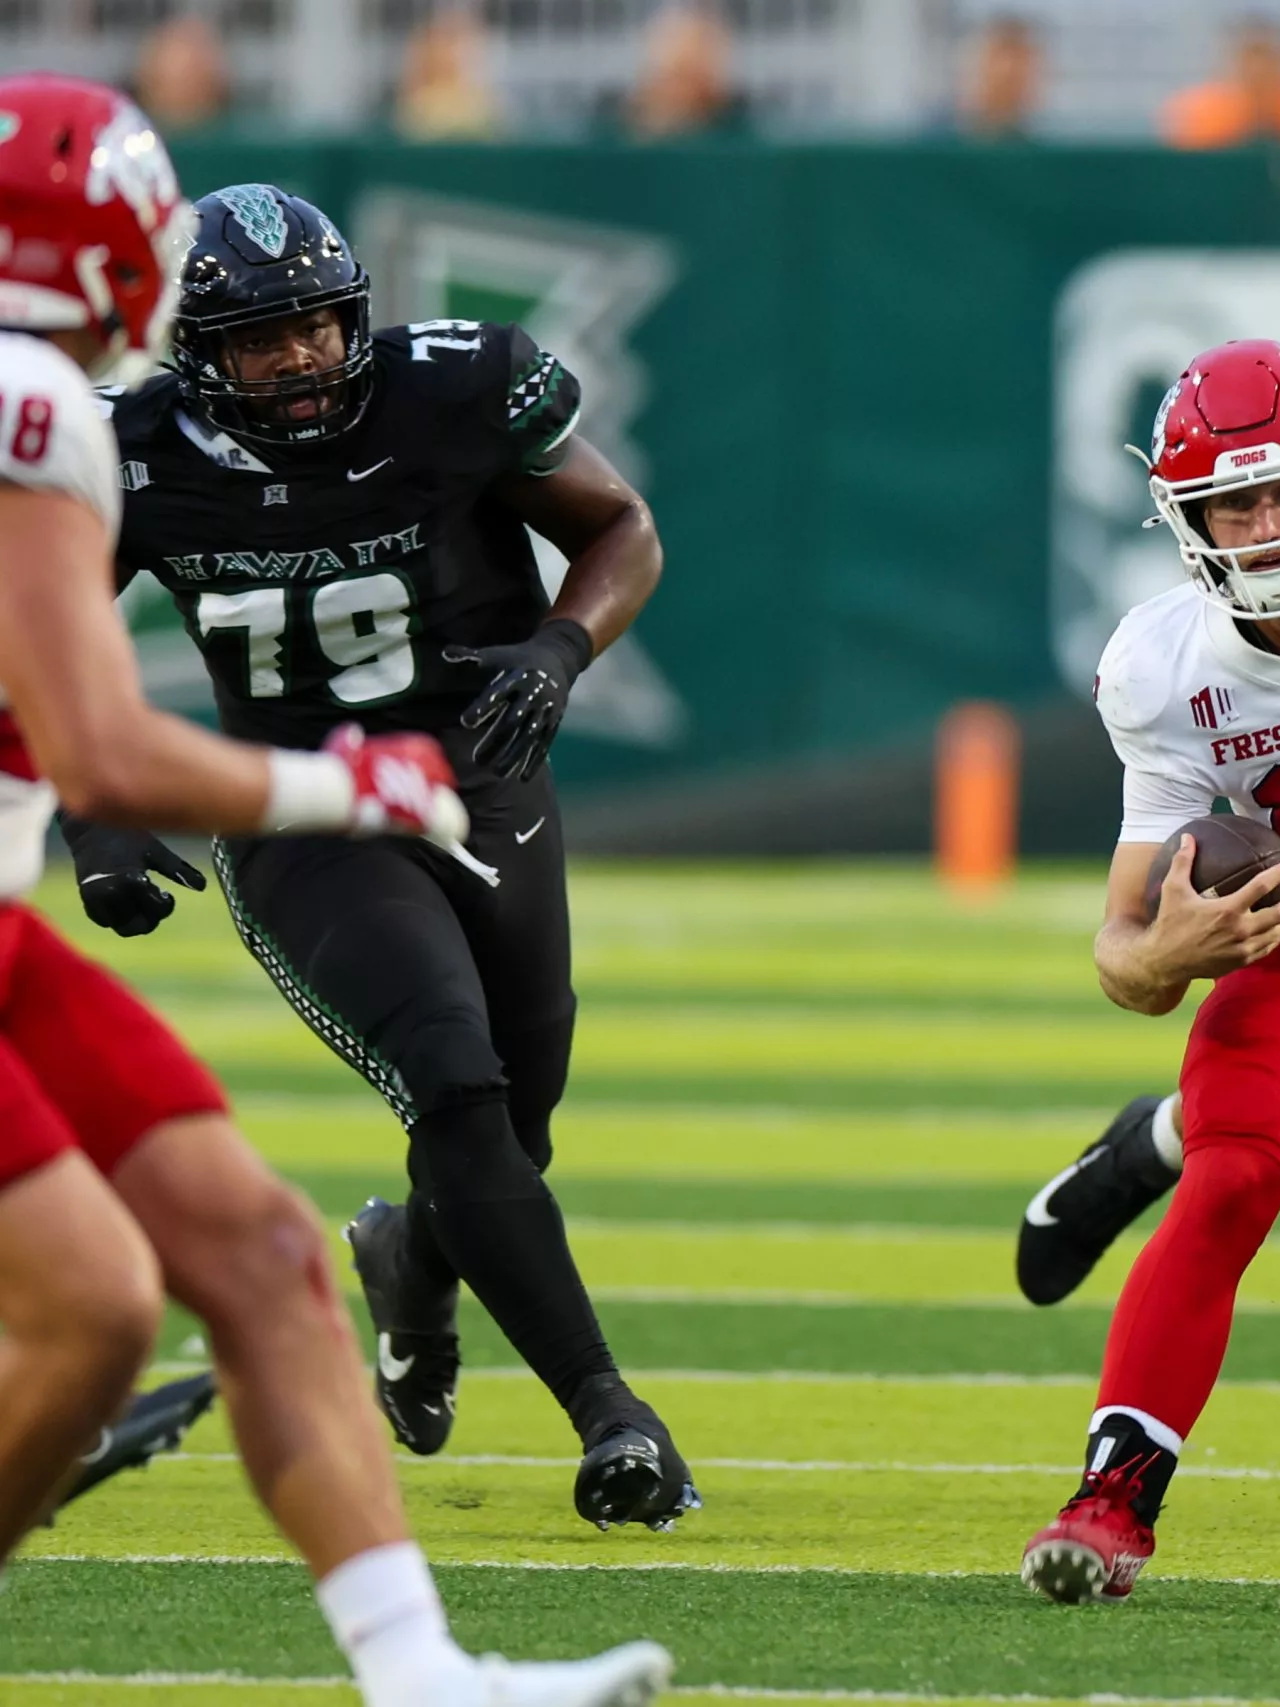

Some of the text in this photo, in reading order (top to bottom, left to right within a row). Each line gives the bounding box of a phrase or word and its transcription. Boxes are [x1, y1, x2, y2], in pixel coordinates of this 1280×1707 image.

[0, 393, 53, 465] 8
[162, 523, 426, 581] HAWAI'I
[196, 571, 418, 705] 79
